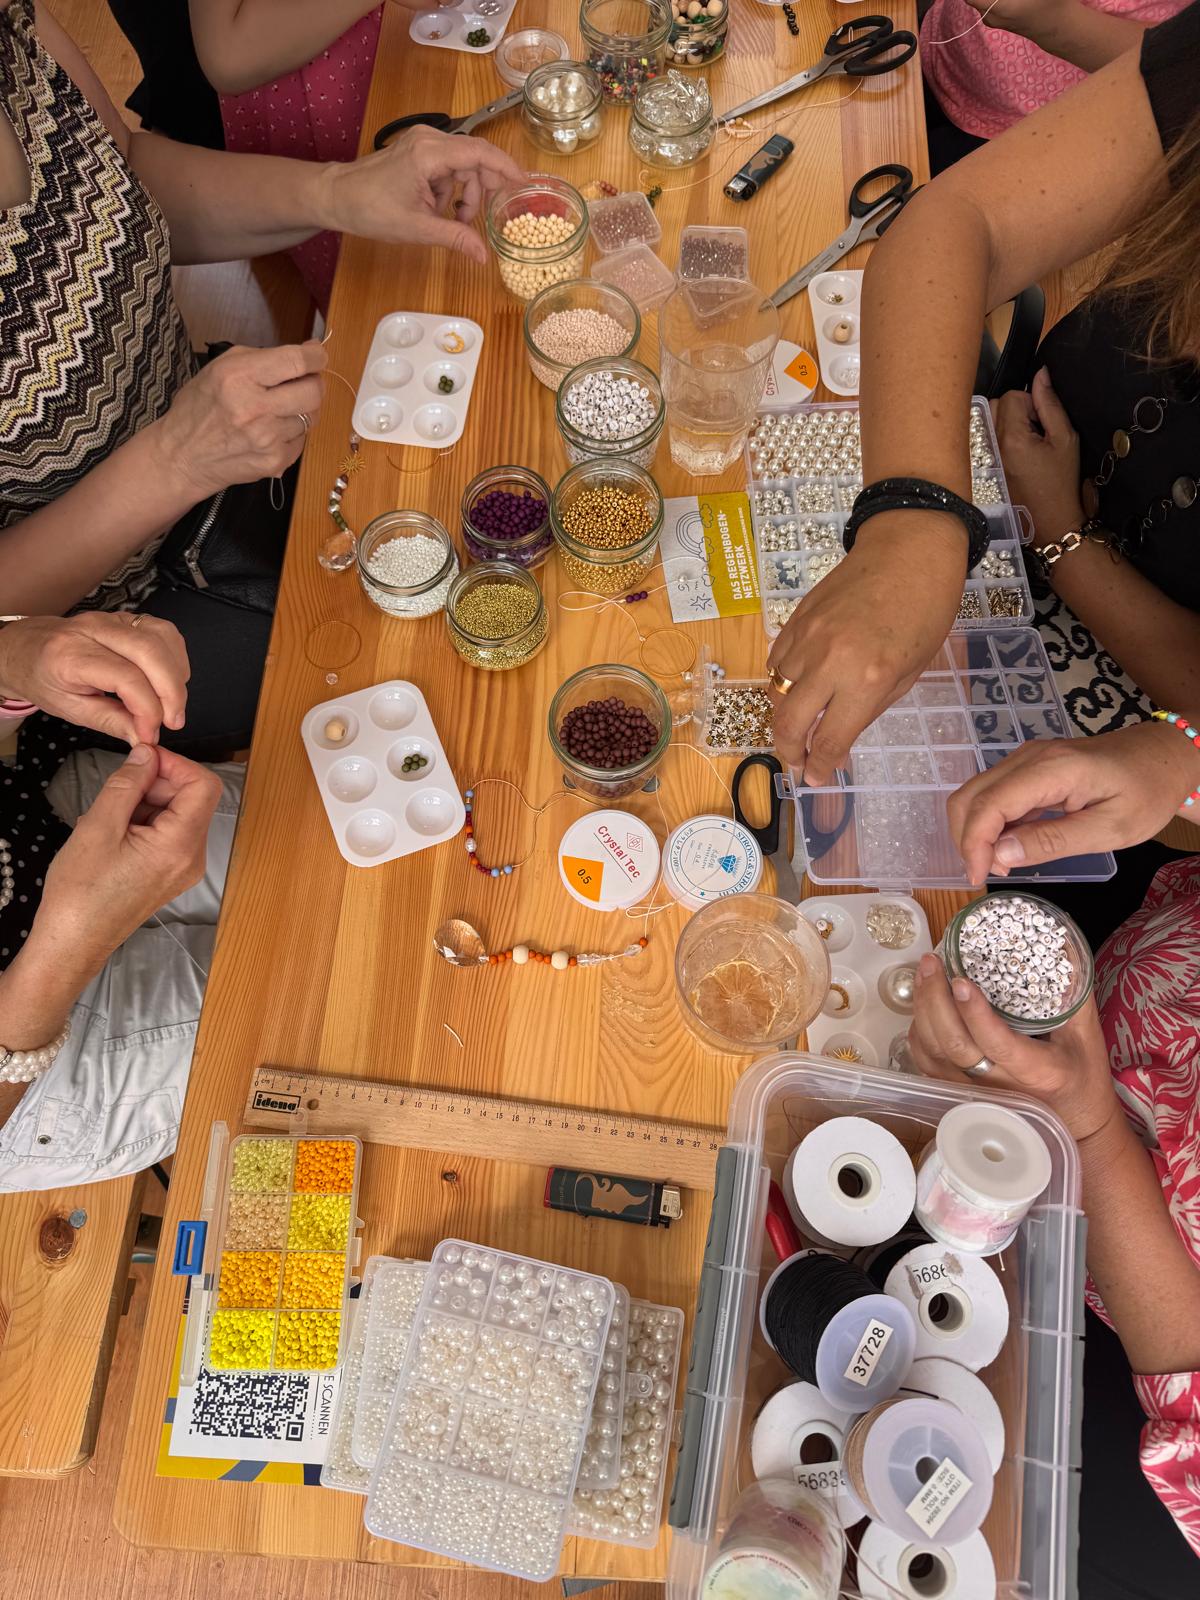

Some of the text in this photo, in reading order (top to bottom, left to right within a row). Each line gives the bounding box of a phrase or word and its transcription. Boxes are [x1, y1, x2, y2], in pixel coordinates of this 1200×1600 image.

[799, 364, 808, 376] 0.5
[717, 510, 742, 600] DAS REGENBOGEN-
[735, 545, 753, 598] NETZWERK
[598, 825, 641, 878] Crystal Tec
[736, 831, 755, 861] STRONG
[577, 868, 592, 885] 0.5
[256, 1094, 297, 1111] idena
[512, 1114, 519, 1122] 16
[853, 1327, 886, 1377] 37728
[318, 1384, 333, 1434] SCANNEN
[944, 1474, 955, 1488] QTY:
[948, 1479, 961, 1495] ITEM
[924, 1495, 938, 1511] ROLL
